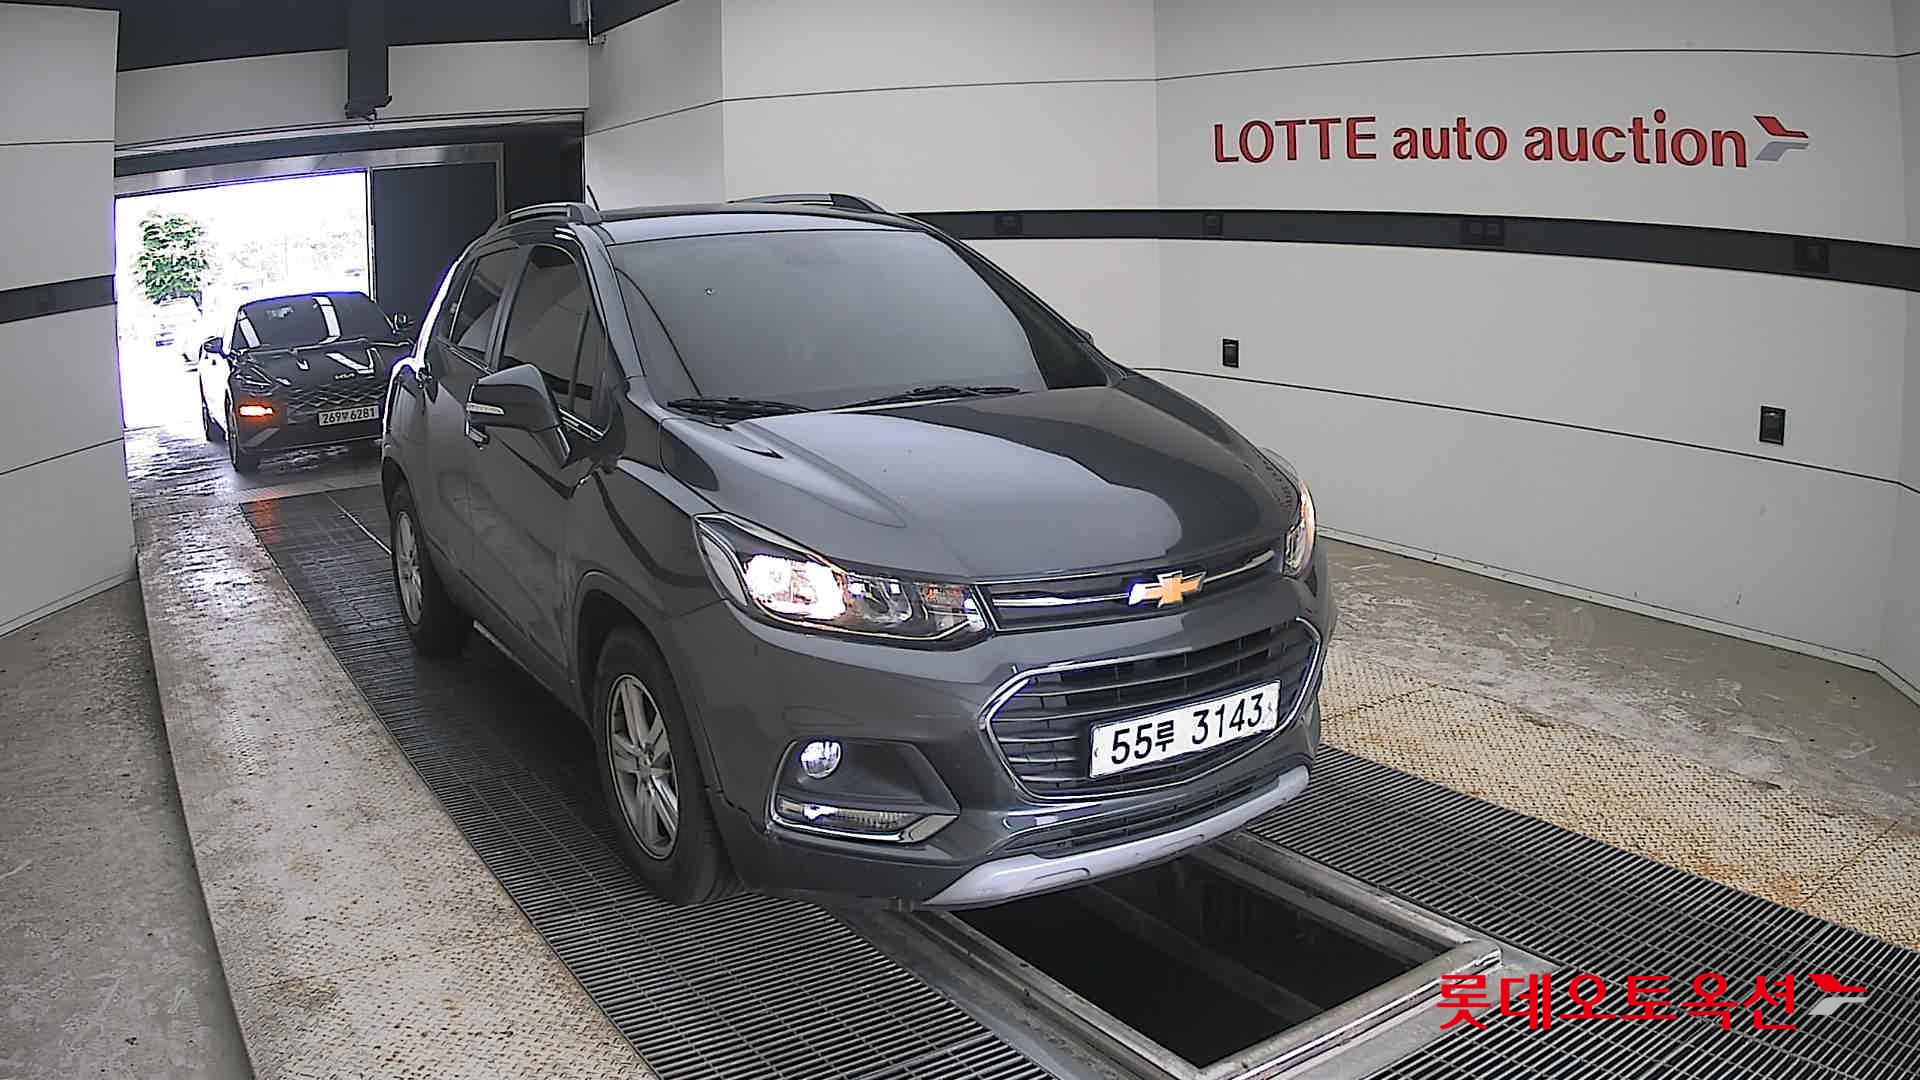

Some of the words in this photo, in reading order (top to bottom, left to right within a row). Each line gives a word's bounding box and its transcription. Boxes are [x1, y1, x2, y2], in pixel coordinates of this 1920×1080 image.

[1214, 115, 1377, 163] LOTTE
[1392, 117, 1508, 161] auto
[1524, 109, 1748, 168] auction
[1111, 720, 1175, 765] 55루
[1191, 692, 1264, 745] 3143
